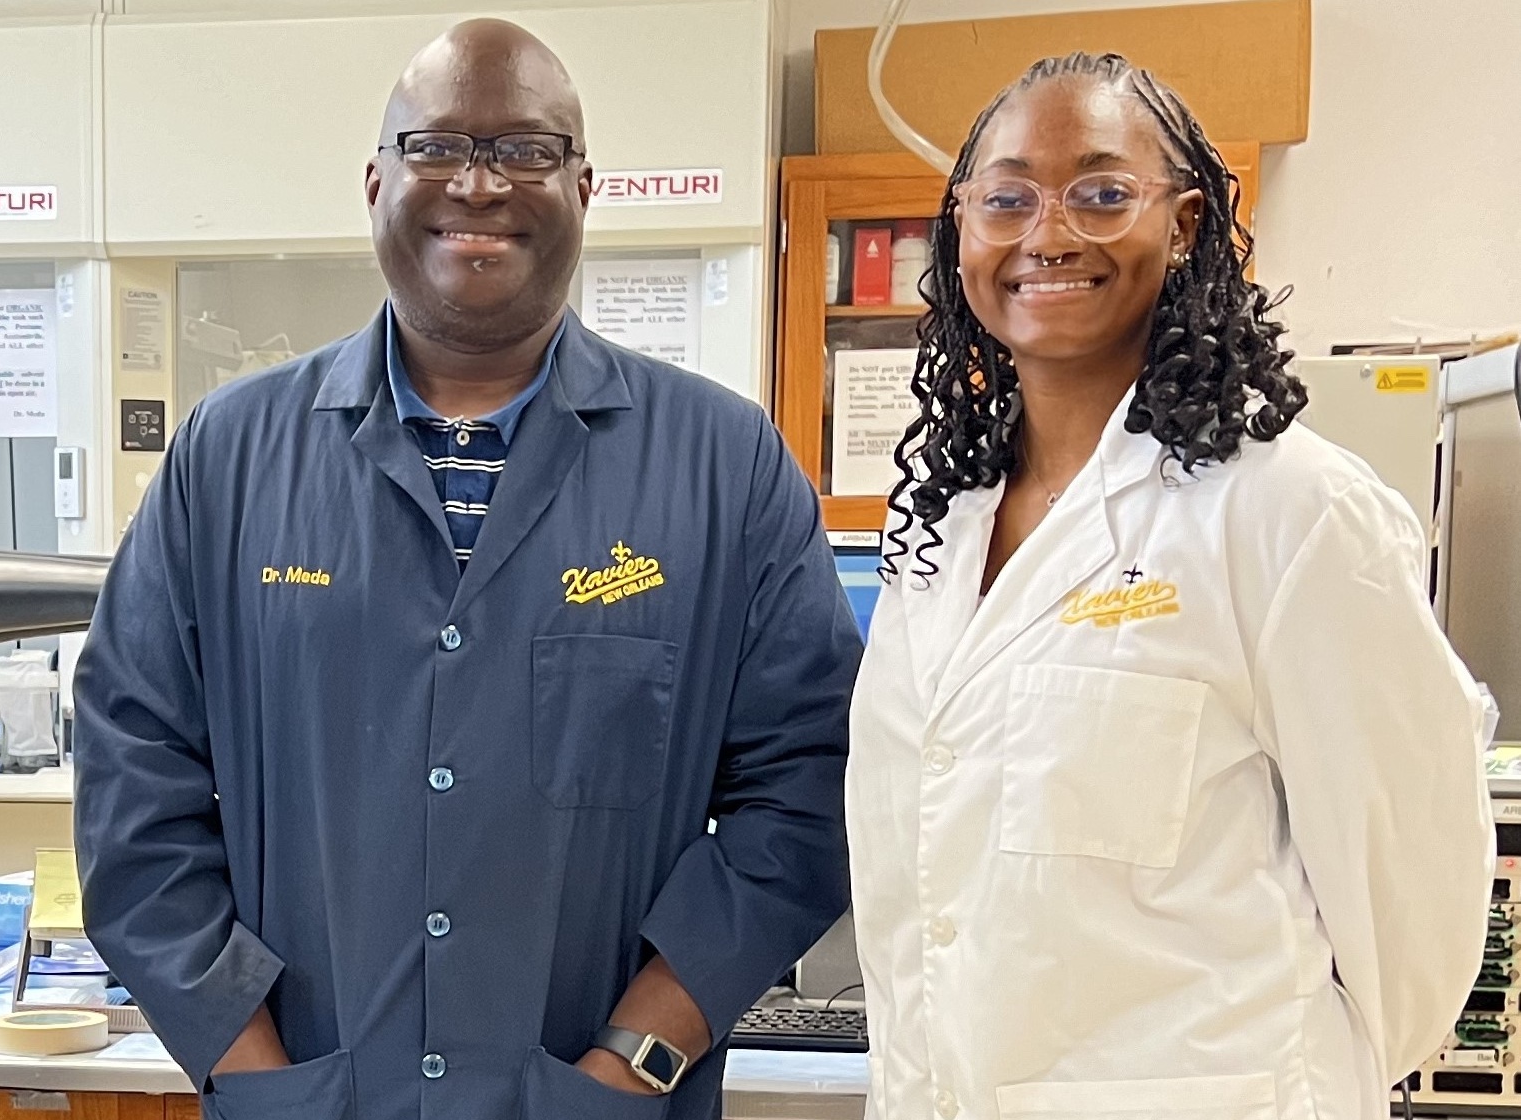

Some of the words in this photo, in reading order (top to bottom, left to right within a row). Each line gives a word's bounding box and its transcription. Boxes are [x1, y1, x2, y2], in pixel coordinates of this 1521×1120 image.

[591, 175, 718, 196] VENTURI
[646, 276, 687, 286] ORGANIC
[127, 291, 158, 299] CAUTION
[6, 304, 44, 313] ORGANIC
[262, 567, 282, 583] Dr.
[285, 566, 330, 586] Meda
[562, 556, 659, 603] Xavier
[601, 587, 623, 605] NEW
[622, 573, 664, 596] ORLEANS
[1060, 581, 1176, 624] Xavier
